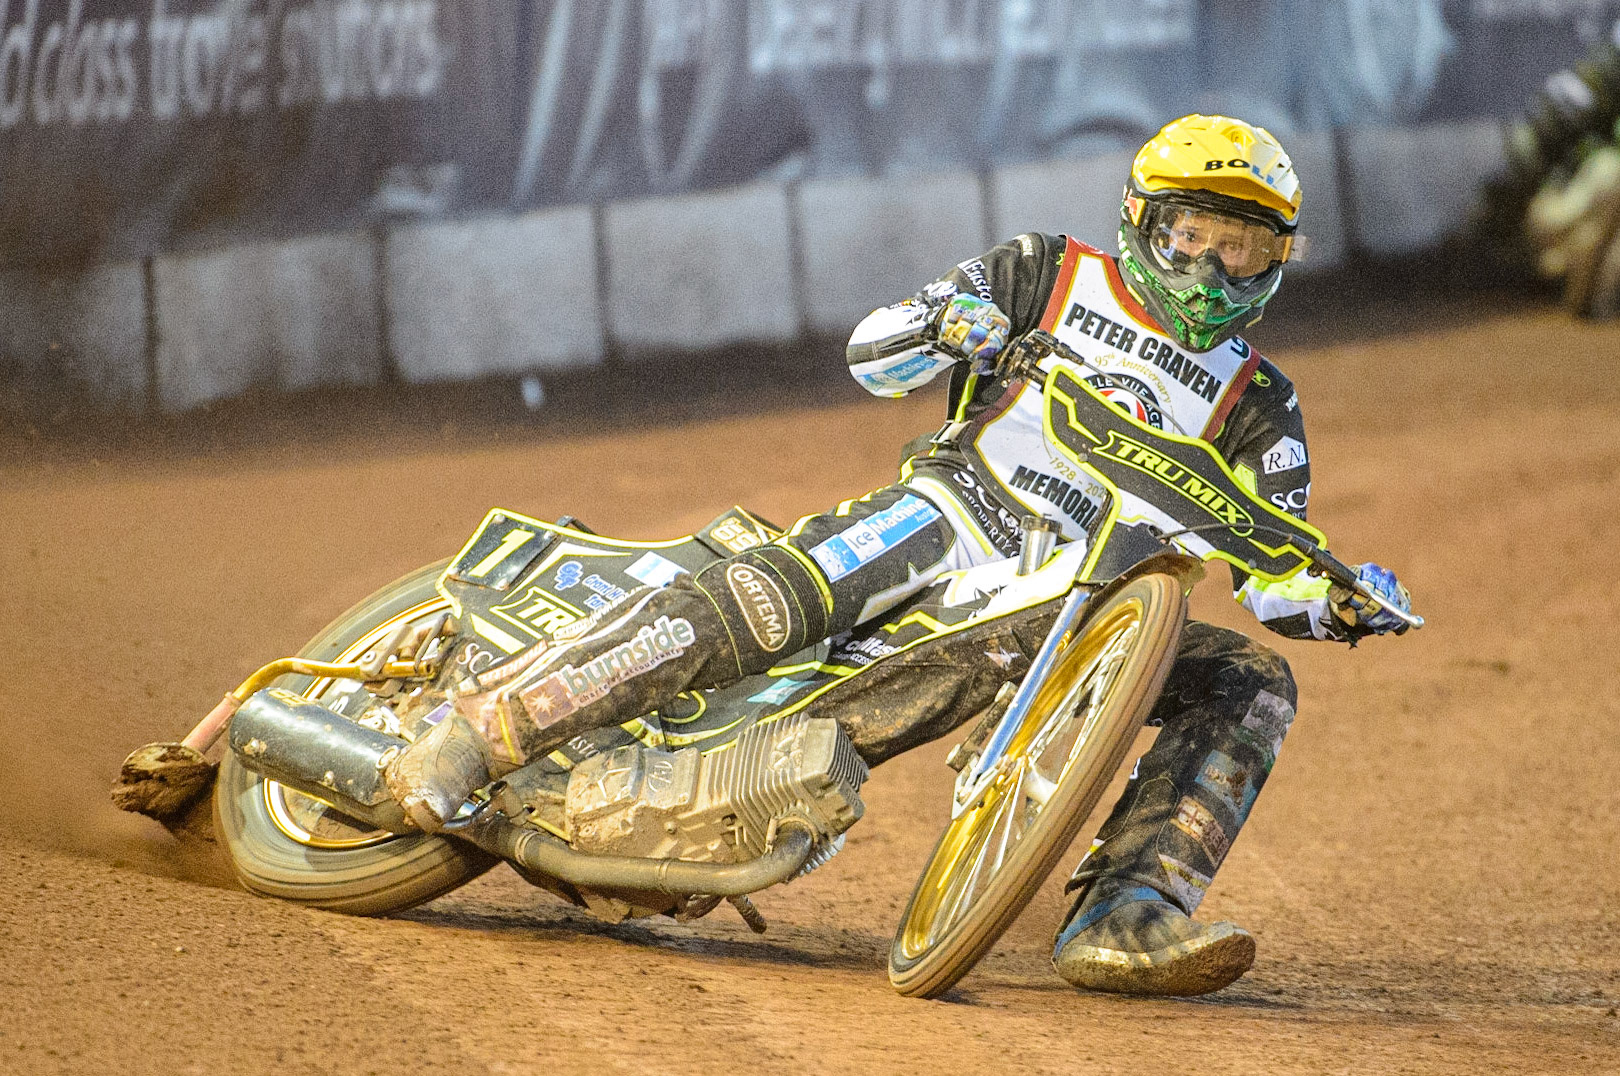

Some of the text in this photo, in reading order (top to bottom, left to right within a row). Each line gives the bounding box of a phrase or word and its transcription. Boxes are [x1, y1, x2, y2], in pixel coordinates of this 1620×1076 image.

[1064, 302, 1222, 404] PETER CRAVEN
[1116, 357, 1171, 404] Anniversary
[1008, 464, 1099, 533] MEMORI
[1050, 457, 1077, 481] 1928
[1085, 482, 1107, 499] 202
[467, 527, 536, 578] 1
[847, 531, 874, 550] Ice
[733, 569, 786, 647] ORTEMA
[562, 619, 692, 695] burnside
